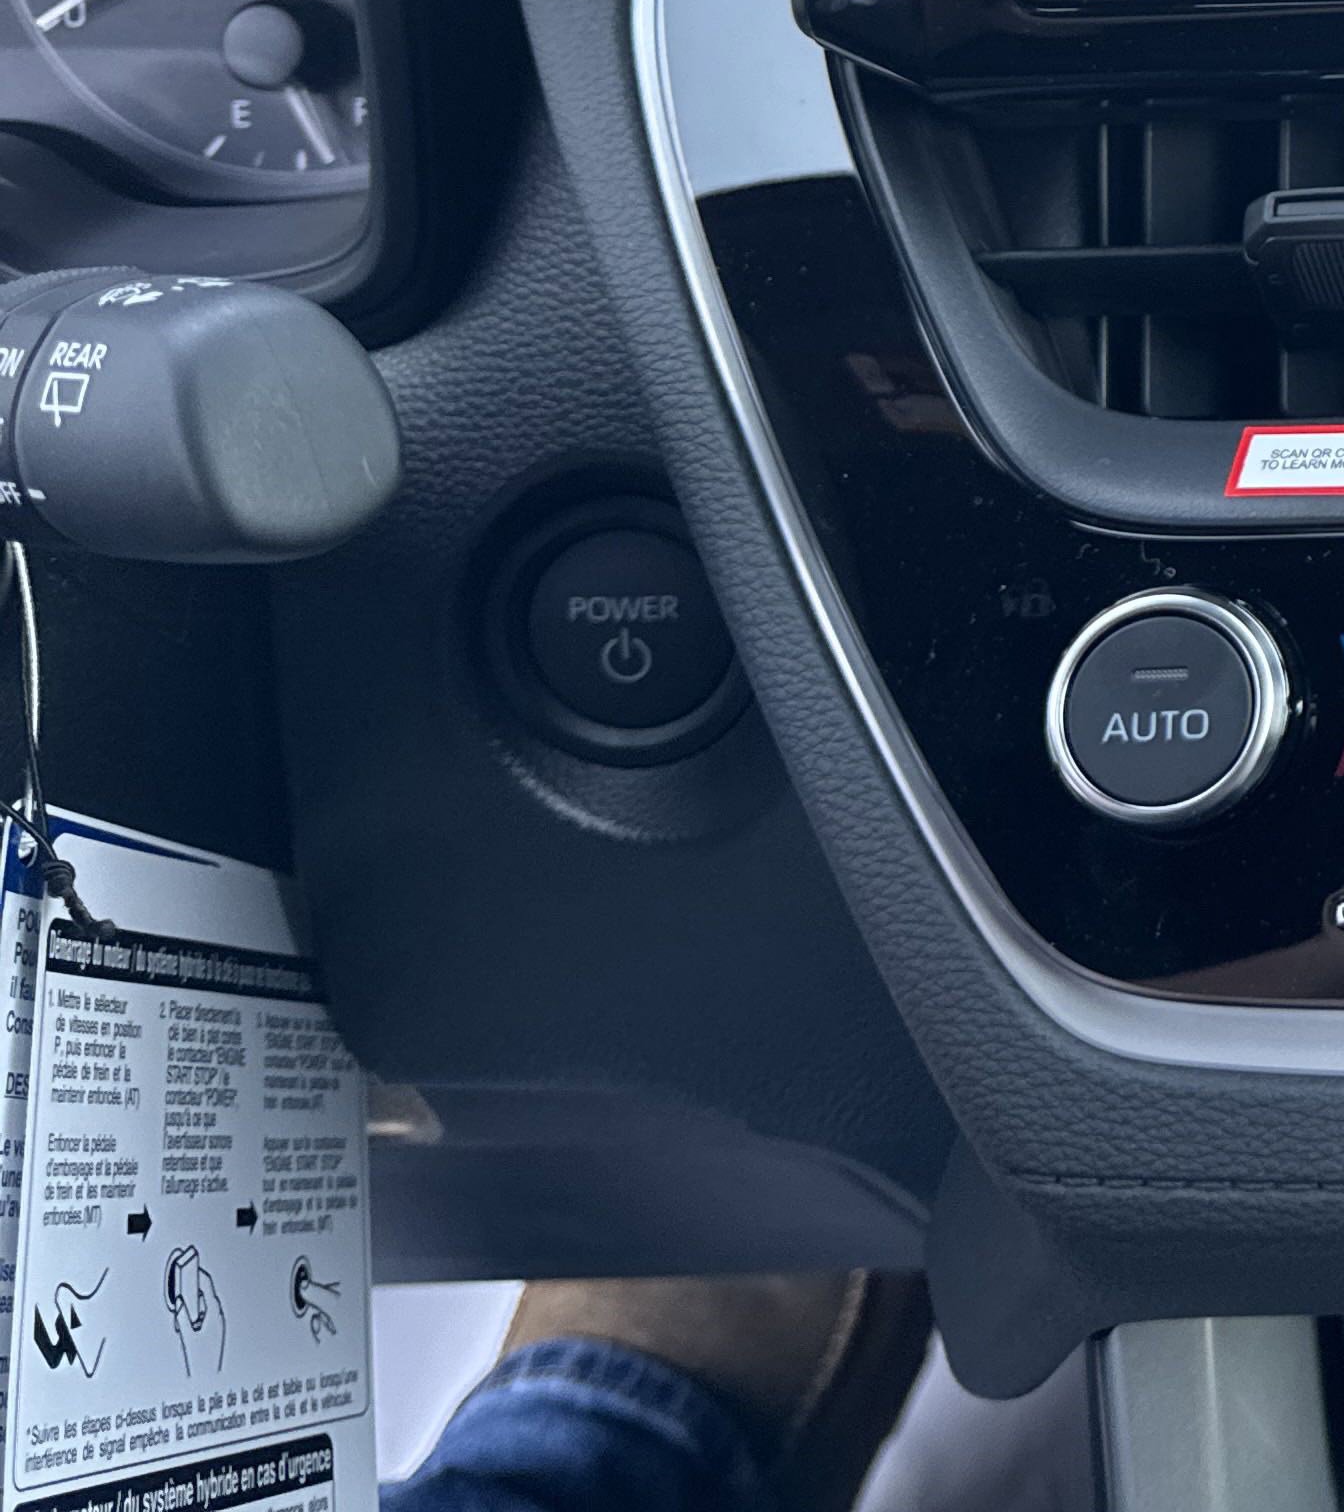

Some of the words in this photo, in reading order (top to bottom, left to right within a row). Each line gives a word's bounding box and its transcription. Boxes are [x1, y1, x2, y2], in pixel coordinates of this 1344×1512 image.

[230, 99, 252, 129] E
[50, 342, 107, 369] REAR
[1261, 459, 1278, 470] TO
[1281, 459, 1329, 470] LEARN
[1270, 447, 1308, 458] SCAN
[1311, 448, 1332, 459] QR
[567, 595, 679, 623] POWER
[1101, 710, 1210, 743] AUTO
[82, 1440, 94, 1461] de
[99, 1433, 126, 1460] signal
[187, 1411, 246, 1438] communication
[143, 1478, 194, 1512] système
[196, 1466, 238, 1509] hybride
[240, 1466, 254, 1492] en
[257, 1460, 276, 1488] cas
[278, 1448, 332, 1484] d'urgence
